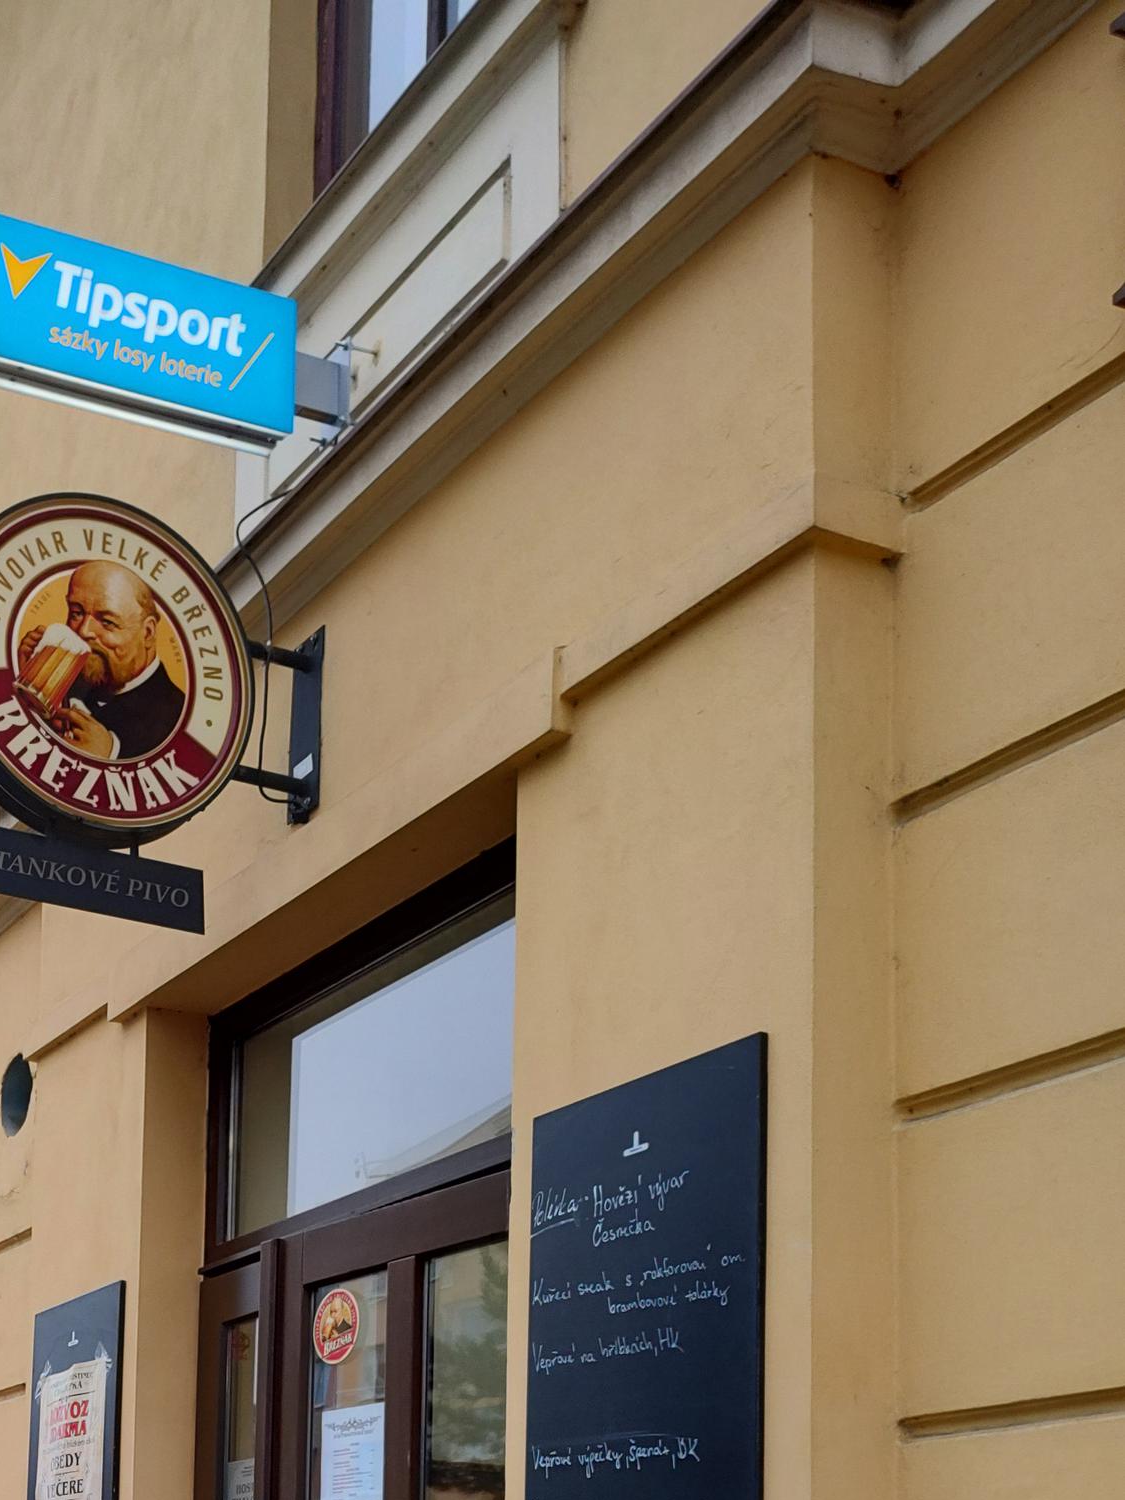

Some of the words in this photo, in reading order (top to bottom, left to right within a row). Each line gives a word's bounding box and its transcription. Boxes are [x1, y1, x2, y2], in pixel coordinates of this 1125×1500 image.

[53, 261, 246, 356] Tipsport
[49, 325, 108, 356] sázky
[114, 336, 155, 372] losy
[160, 350, 222, 388] loterie
[83, 528, 169, 582] VELKÉ
[171, 585, 224, 702] BŘEZNO
[125, 878, 189, 908] PIVO
[581, 1352, 596, 1364] na
